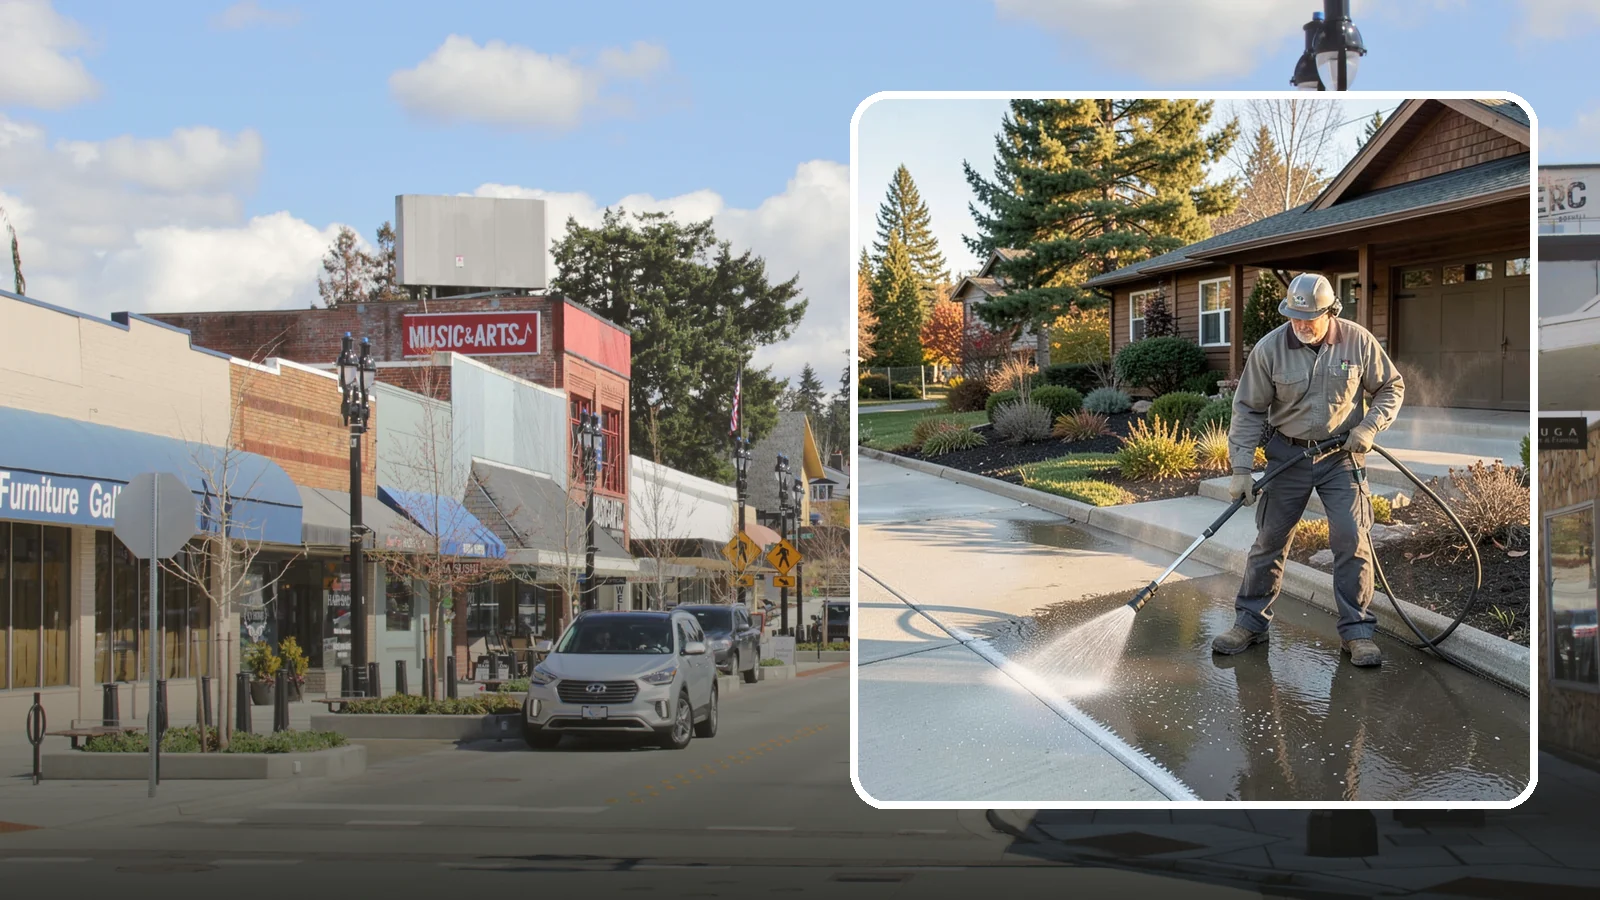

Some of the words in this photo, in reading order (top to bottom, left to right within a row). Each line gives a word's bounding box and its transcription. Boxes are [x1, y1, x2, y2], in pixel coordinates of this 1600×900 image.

[0, 471, 79, 515] Furniture
[89, 482, 122, 519] Gal
[452, 563, 479, 574] SUSHI
